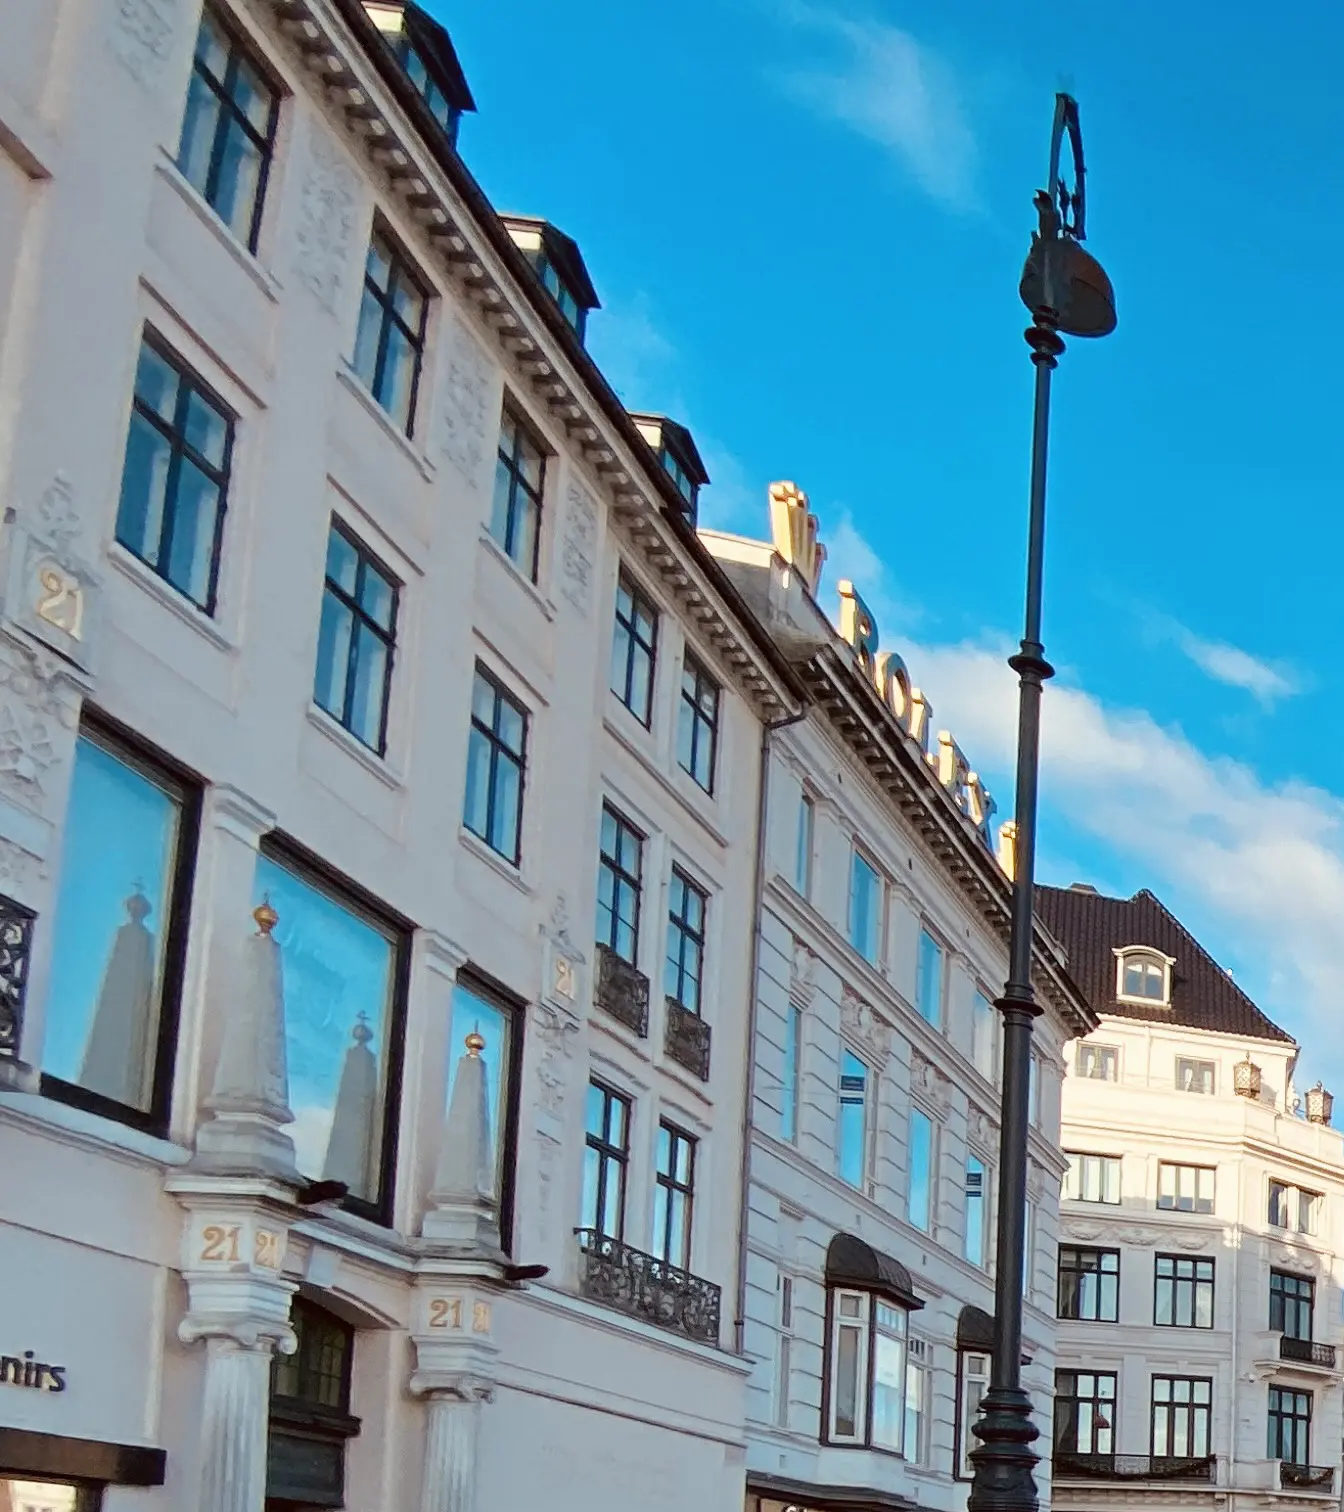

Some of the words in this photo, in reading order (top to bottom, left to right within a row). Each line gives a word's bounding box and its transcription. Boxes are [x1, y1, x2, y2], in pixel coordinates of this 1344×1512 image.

[200, 1225, 241, 1262] 21
[429, 1299, 462, 1329] 21
[0, 1350, 66, 1392] nirs
